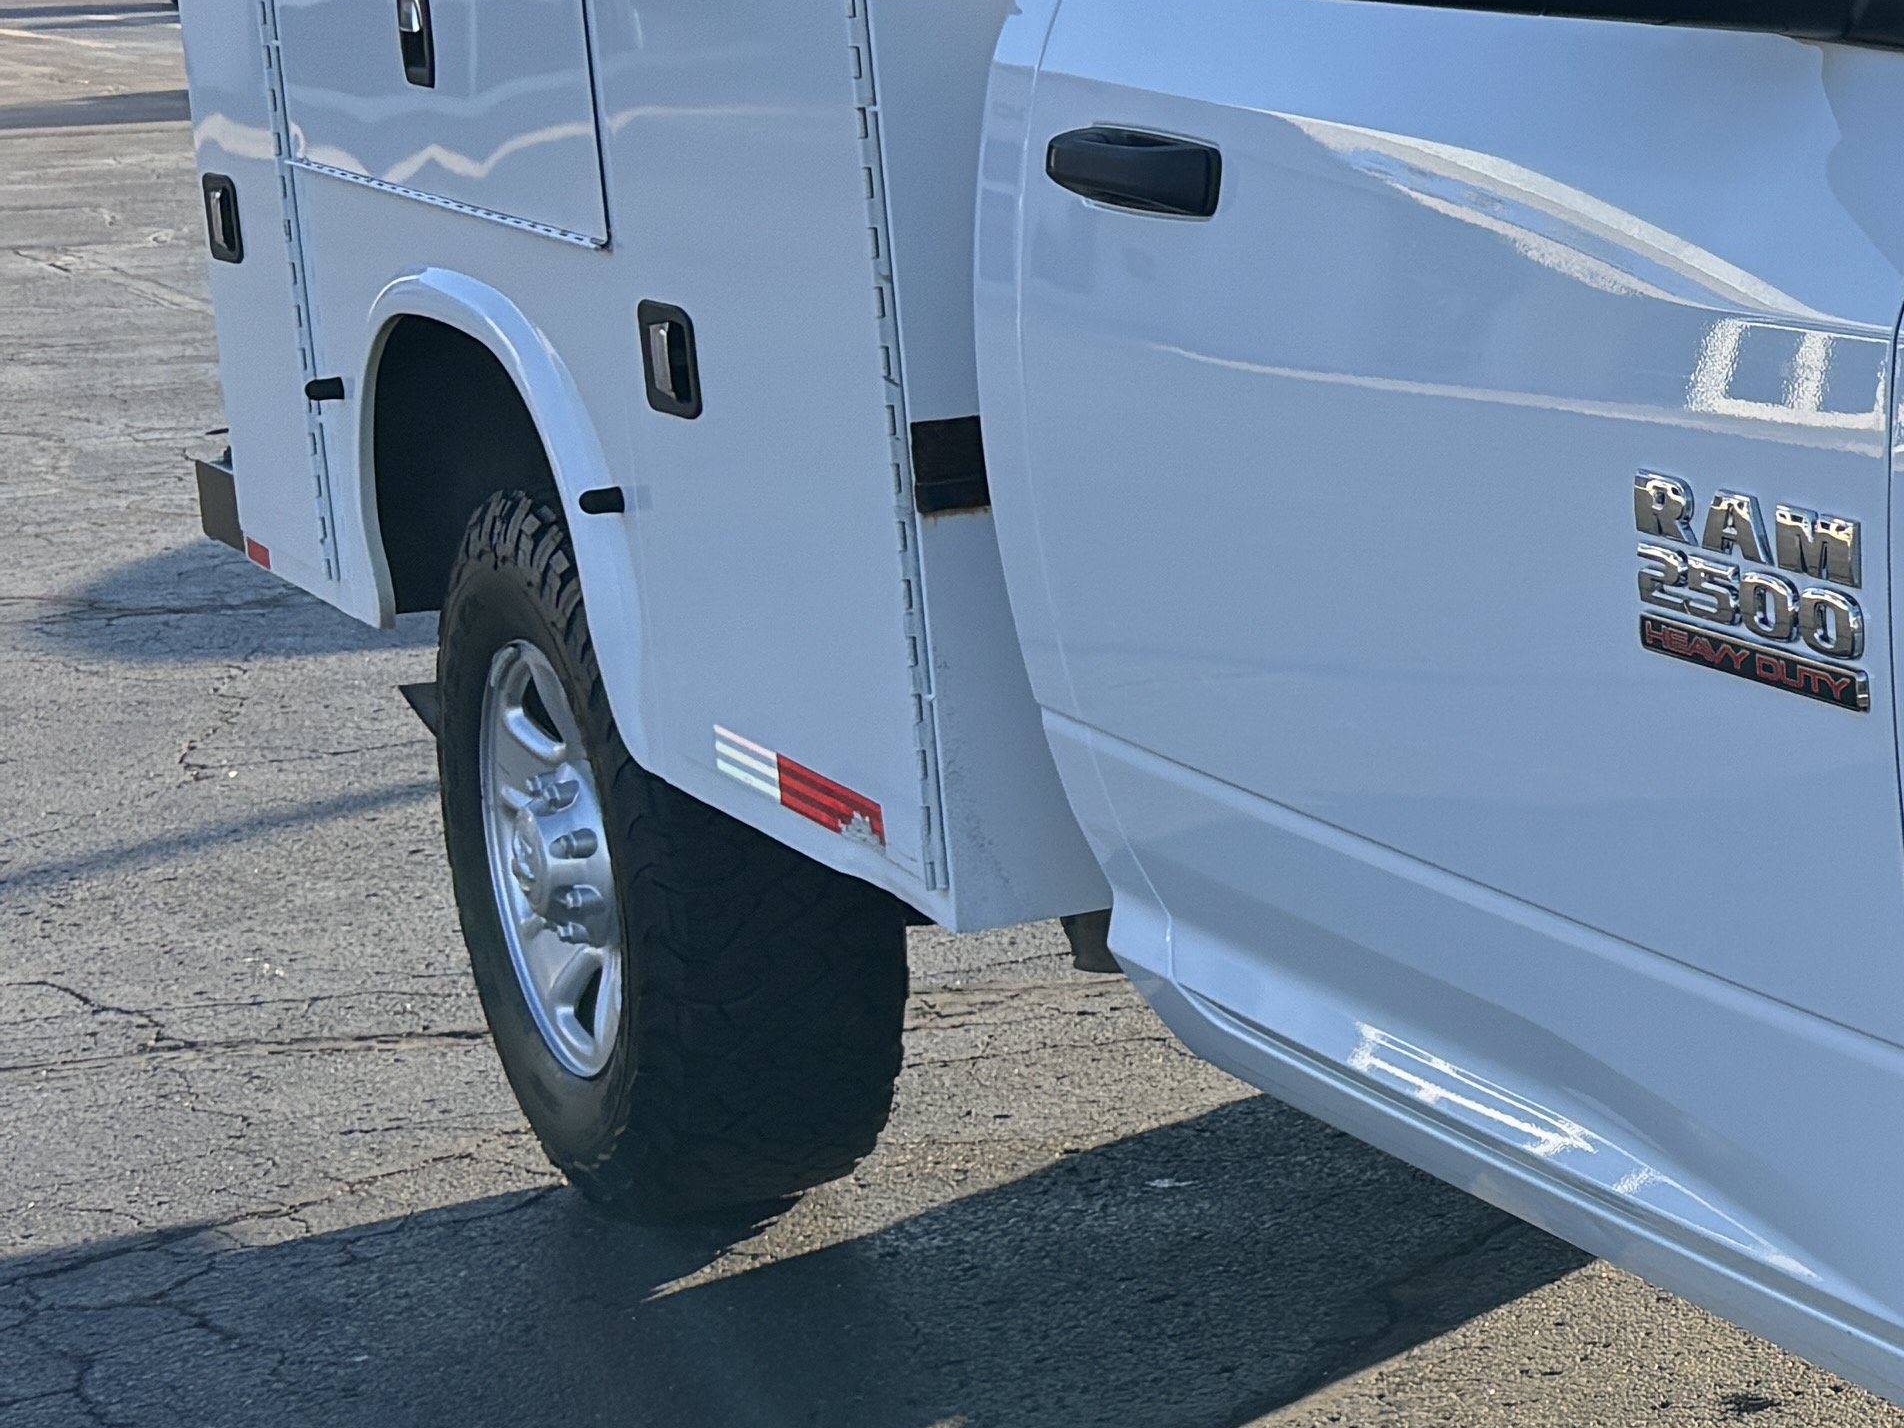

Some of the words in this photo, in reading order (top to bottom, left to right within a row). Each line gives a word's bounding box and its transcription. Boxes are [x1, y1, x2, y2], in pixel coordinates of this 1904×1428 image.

[1634, 468, 1862, 589] RAM
[1637, 542, 1865, 660] 2500
[1645, 620, 1749, 669] HEAVY
[1756, 654, 1850, 700] DUTY
